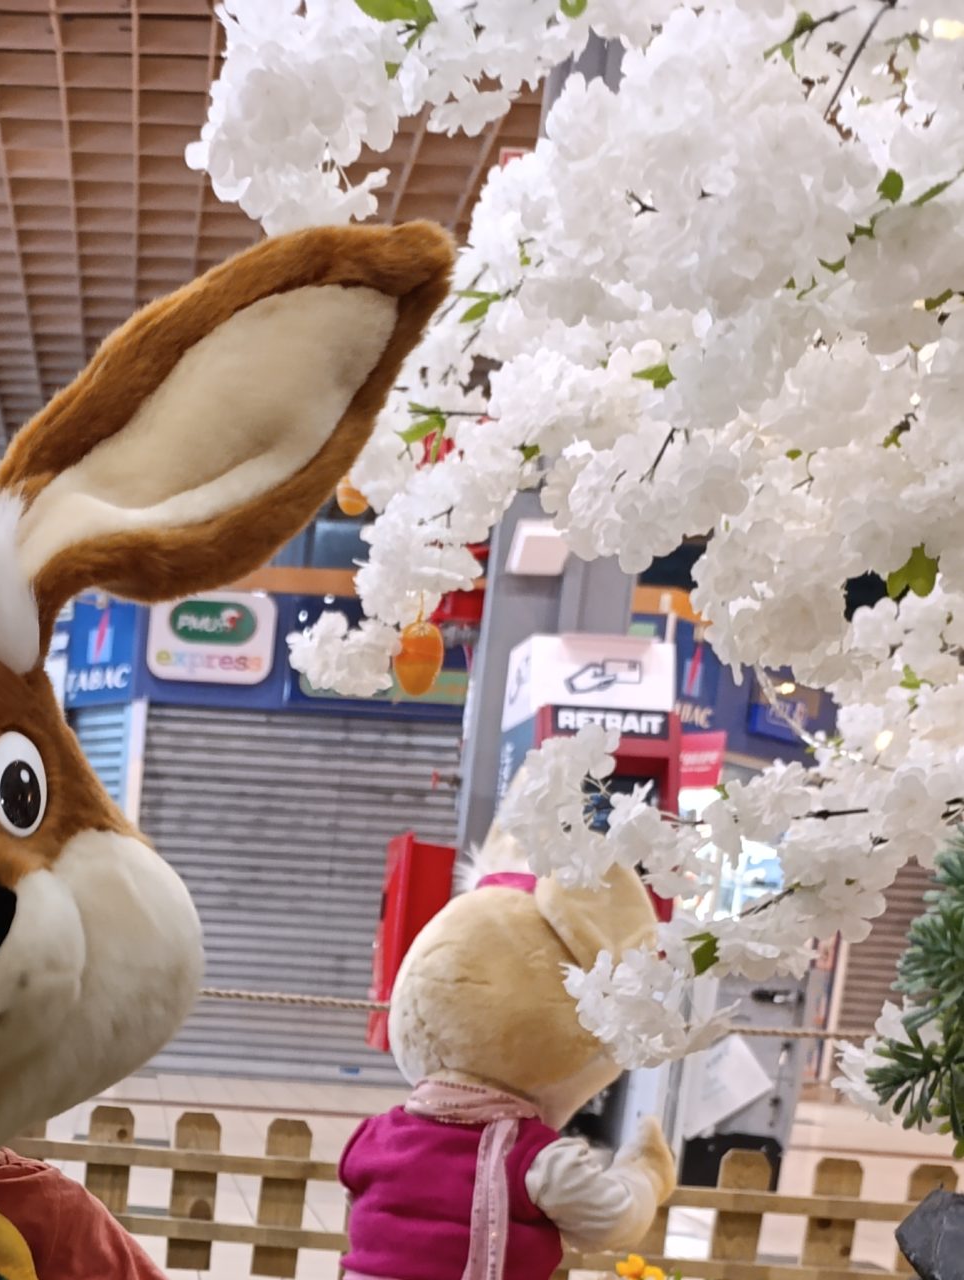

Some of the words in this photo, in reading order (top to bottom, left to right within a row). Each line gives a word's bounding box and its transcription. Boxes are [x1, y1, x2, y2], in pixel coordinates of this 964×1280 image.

[176, 613, 218, 633] PMU
[155, 649, 264, 675] express
[66, 664, 132, 694] TABAC
[557, 707, 665, 735] RETRAIT
